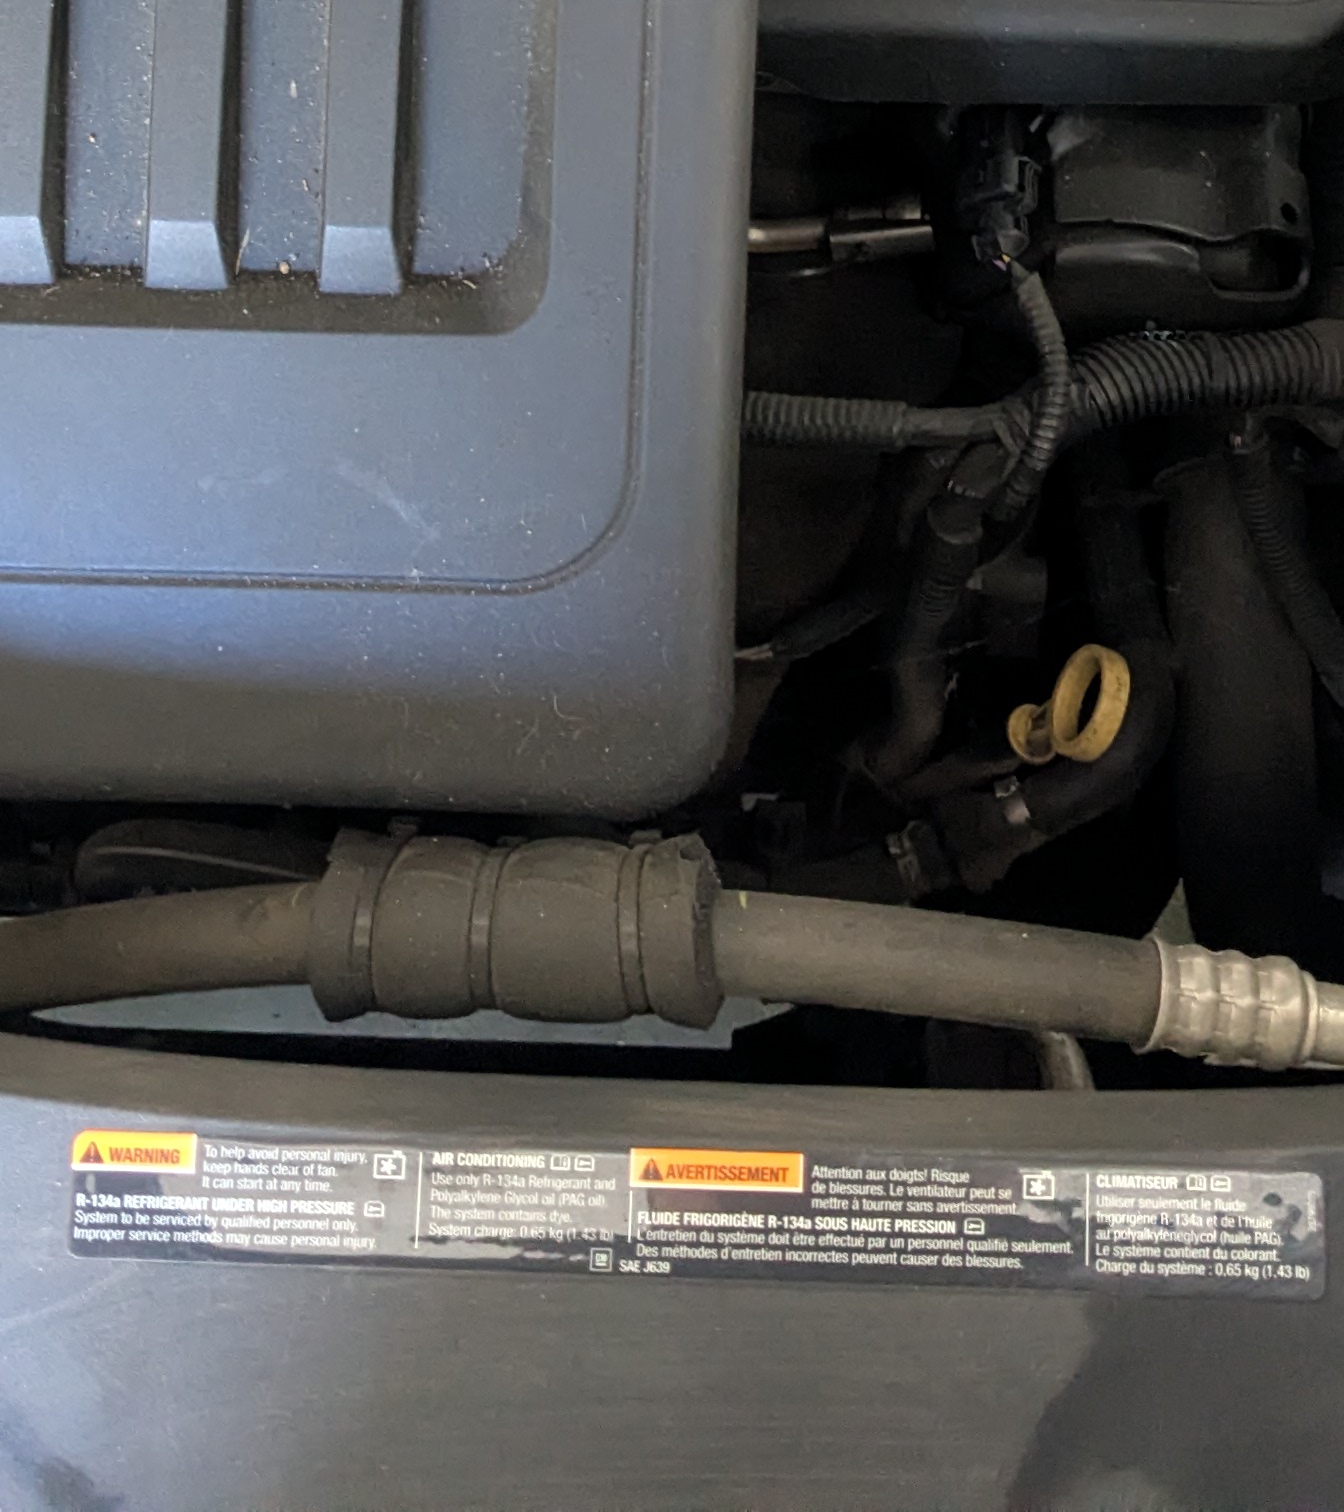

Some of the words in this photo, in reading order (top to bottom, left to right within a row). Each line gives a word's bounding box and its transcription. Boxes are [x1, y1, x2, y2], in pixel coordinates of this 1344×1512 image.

[109, 1147, 180, 1164] WARNING
[205, 1145, 218, 1158] To
[220, 1146, 246, 1163] help
[248, 1146, 278, 1161] avoid
[282, 1148, 331, 1165] personal
[334, 1149, 367, 1166] injury.
[432, 1152, 453, 1166] AIR
[458, 1153, 545, 1168] CONDITIONING
[203, 1162, 228, 1177] keep
[231, 1161, 268, 1176] hands
[272, 1163, 300, 1176] clear
[303, 1163, 315, 1176] of
[317, 1164, 338, 1177] fan.
[665, 1164, 789, 1183] AVERTISSEMENT
[812, 1166, 862, 1179] Attention
[866, 1169, 886, 1180] aux
[889, 1168, 927, 1183] doigts!
[931, 1169, 969, 1184] Risque
[202, 1177, 212, 1188] It
[215, 1179, 233, 1189] can
[237, 1178, 263, 1190] start
[266, 1179, 277, 1191] at
[280, 1181, 299, 1195] any
[302, 1179, 332, 1192] time.
[812, 1182, 826, 1194] de
[829, 1183, 886, 1196] blessures.
[890, 1185, 903, 1197] Le
[907, 1184, 965, 1199] ventilateur
[970, 1187, 995, 1200] peut
[998, 1188, 1011, 1199] se
[1096, 1175, 1178, 1189] CLIMATISEUR
[76, 1193, 120, 1208] R-134a
[124, 1195, 208, 1211] REFRIGERANT
[211, 1197, 253, 1213] UNDER
[257, 1199, 288, 1214] HIGH
[291, 1199, 354, 1216] PRESSURE
[812, 1199, 848, 1210] mettre
[852, 1198, 859, 1210] à
[862, 1199, 902, 1212] tourner
[906, 1202, 934, 1213] sans
[936, 1202, 1017, 1215] avertissement.
[1096, 1195, 1135, 1209] Utiliser
[1139, 1196, 1198, 1210] seulement
[1201, 1198, 1211, 1210] le
[1214, 1198, 1247, 1211] fluide
[74, 1209, 118, 1225] System
[121, 1211, 132, 1224] to
[136, 1212, 150, 1225] be
[153, 1213, 202, 1227] serviced
[205, 1214, 218, 1230] by
[221, 1215, 270, 1231] qualified
[273, 1217, 329, 1233] personnel
[332, 1218, 358, 1234] only.
[638, 1211, 679, 1225] FLUIDE
[682, 1215, 763, 1229] FRIGORIGÈNE
[768, 1218, 811, 1230] R-134a
[815, 1217, 848, 1231] SOUS
[852, 1218, 891, 1232] HAUTE
[895, 1220, 956, 1233] PRESSION
[74, 1225, 126, 1243] Improper
[129, 1228, 170, 1241] service
[173, 1229, 222, 1243] methods
[226, 1232, 250, 1247] may
[254, 1234, 287, 1245] cause
[291, 1234, 339, 1249] personal
[343, 1235, 376, 1249] injury.
[637, 1229, 697, 1242] L'entretien
[701, 1230, 715, 1243] du
[718, 1230, 761, 1246] système
[768, 1233, 790, 1246] doit
[794, 1233, 815, 1246] être
[819, 1233, 864, 1248] effectué
[868, 1236, 886, 1250] par
[890, 1238, 904, 1248] un
[908, 1237, 964, 1251] personnel
[967, 1238, 1007, 1253] qualifié
[1011, 1241, 1073, 1253] seulement.
[637, 1244, 657, 1258] Des
[661, 1245, 717, 1259] méthodes
[721, 1245, 782, 1261] d'entretien
[785, 1248, 848, 1264] incorrectes
[852, 1251, 897, 1266] peuvent
[900, 1255, 938, 1266] causer
[942, 1254, 962, 1266] des
[965, 1255, 1023, 1269] blessures.
[1096, 1243, 1109, 1256] Le
[1113, 1244, 1161, 1260] système
[1164, 1246, 1210, 1259] contient
[1214, 1248, 1228, 1260] du
[1231, 1248, 1281, 1262] colorant.
[619, 1259, 640, 1273] SAE
[643, 1261, 670, 1274] J639
[1096, 1261, 1136, 1275] Charge
[1140, 1262, 1154, 1274] du
[1157, 1262, 1205, 1277] système
[1216, 1265, 1241, 1277] 0.65
[1245, 1265, 1259, 1280] kg
[1262, 1265, 1291, 1280] (1.43
[1295, 1266, 1310, 1281] lb)
